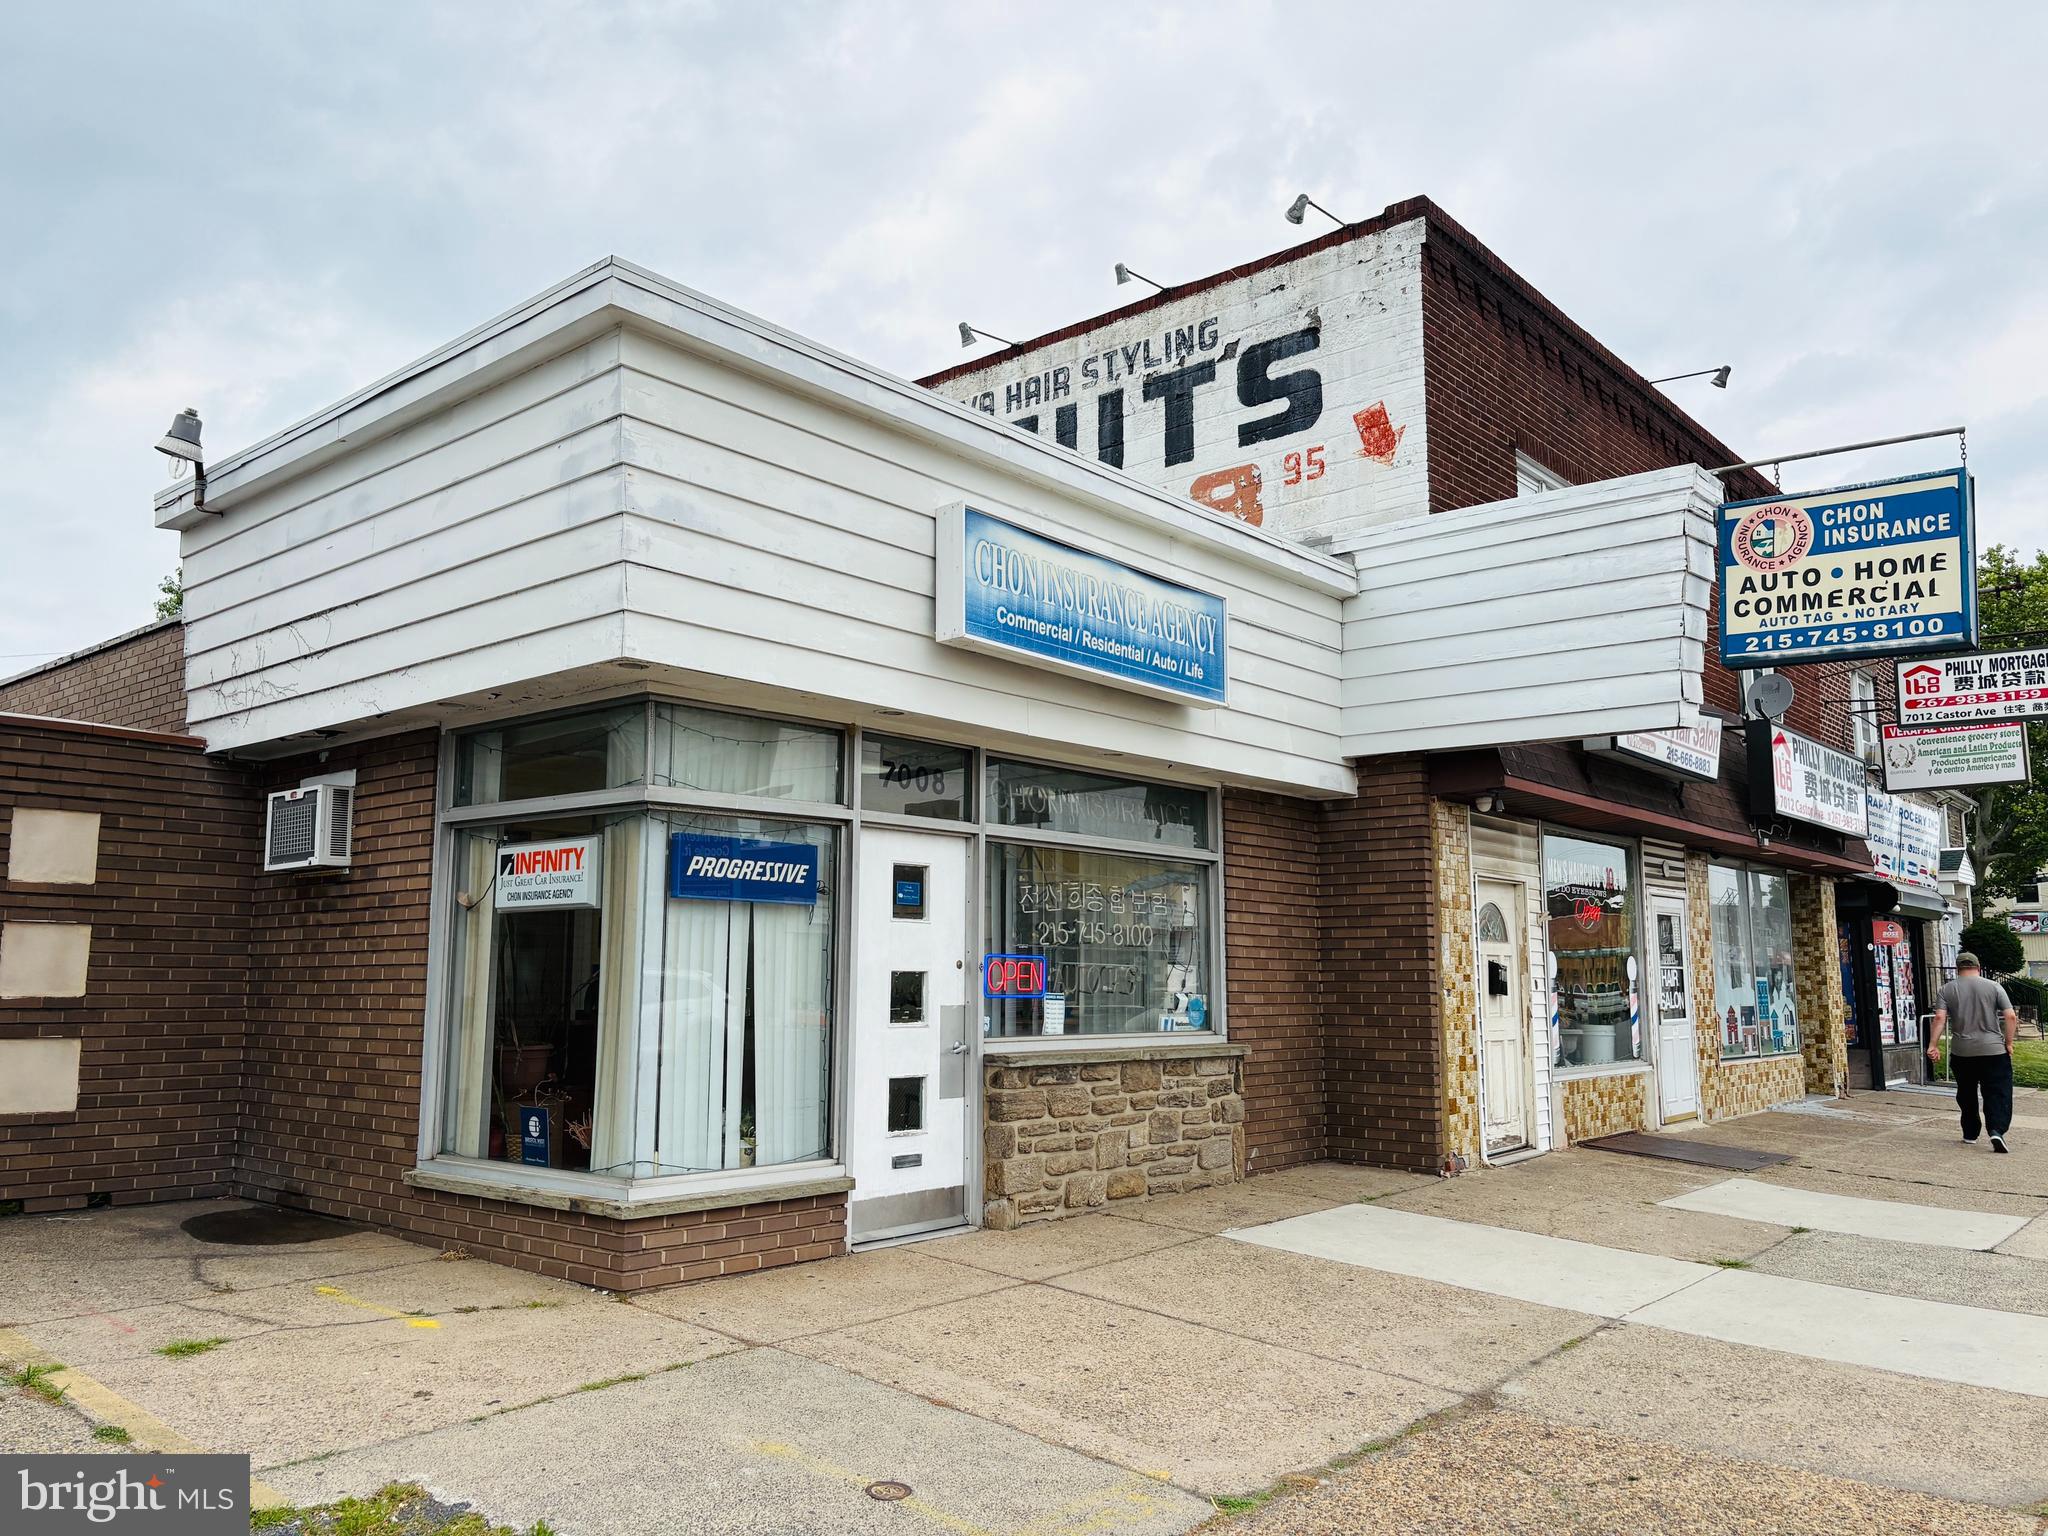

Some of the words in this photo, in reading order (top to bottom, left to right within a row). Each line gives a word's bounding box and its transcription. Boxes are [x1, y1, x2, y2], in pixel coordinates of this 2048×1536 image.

[1006, 365, 1070, 414] HAIR
[1082, 317, 1218, 390] STYLING
[1284, 445, 1326, 485] 95
[1756, 507, 1790, 519] CHON
[1822, 502, 1884, 526] CHON
[1787, 519, 1808, 563] AGENCY
[1824, 513, 1951, 546] INSURANCE
[1738, 524, 1776, 570] INSURANCE
[1740, 568, 1821, 594] AUTO
[1854, 552, 1948, 580] HOME
[974, 539, 1037, 598] CHON
[1041, 559, 1148, 633] INSURANCE
[1151, 599, 1217, 656] AGENCY
[1734, 577, 1941, 618] COMMERCIAL
[1759, 615, 1799, 628] AUTO
[1803, 611, 1833, 624] TAG
[1855, 602, 1920, 618] NOTARY
[996, 606, 1073, 643] Commercial
[1082, 630, 1144, 662] Residential
[1152, 655, 1177, 672] Auto
[1185, 659, 1204, 680] Life
[1946, 659, 1983, 676] PHILLY
[1917, 689, 2041, 709] 267-983-3159
[1905, 712, 1933, 723] 7012
[1936, 710, 1971, 720] Castor
[1975, 707, 1997, 717] Ave
[1692, 720, 1719, 755] Salon
[1916, 735, 1966, 746] Convenience
[1967, 731, 1998, 743] grocery
[2000, 729, 2020, 739] store
[1917, 747, 1952, 757] American
[1953, 745, 1968, 754] and
[1969, 743, 1988, 753] Latin
[1989, 740, 2022, 751] Products
[1792, 737, 1821, 771] PHILLY
[1823, 750, 1865, 788] MORTGAGE
[1931, 757, 1970, 767] Productos
[1972, 752, 2017, 764] americanos
[1933, 766, 1942, 775] de
[1944, 765, 1965, 774] centro
[883, 760, 945, 795] 7008
[990, 777, 1064, 815] CHON
[1894, 804, 1928, 827] GROCERY
[1873, 834, 1894, 849] CASTOR
[515, 846, 584, 875] INFINITY
[686, 855, 810, 884] PROGRESSIVE
[514, 875, 533, 887] GREAT
[534, 873, 548, 886] CAR
[1561, 885, 1571, 893] DO
[1571, 886, 1607, 898] EYEBROWS
[507, 890, 521, 902] CHON
[522, 889, 551, 901] INSURANCE
[552, 888, 574, 899] AGENCY
[1575, 898, 1601, 925] Open
[1038, 918, 1154, 946] 215-745-8100
[987, 960, 1043, 992] OPEN
[1661, 969, 1679, 987] HAIR
[1660, 991, 1685, 1010] SALON
